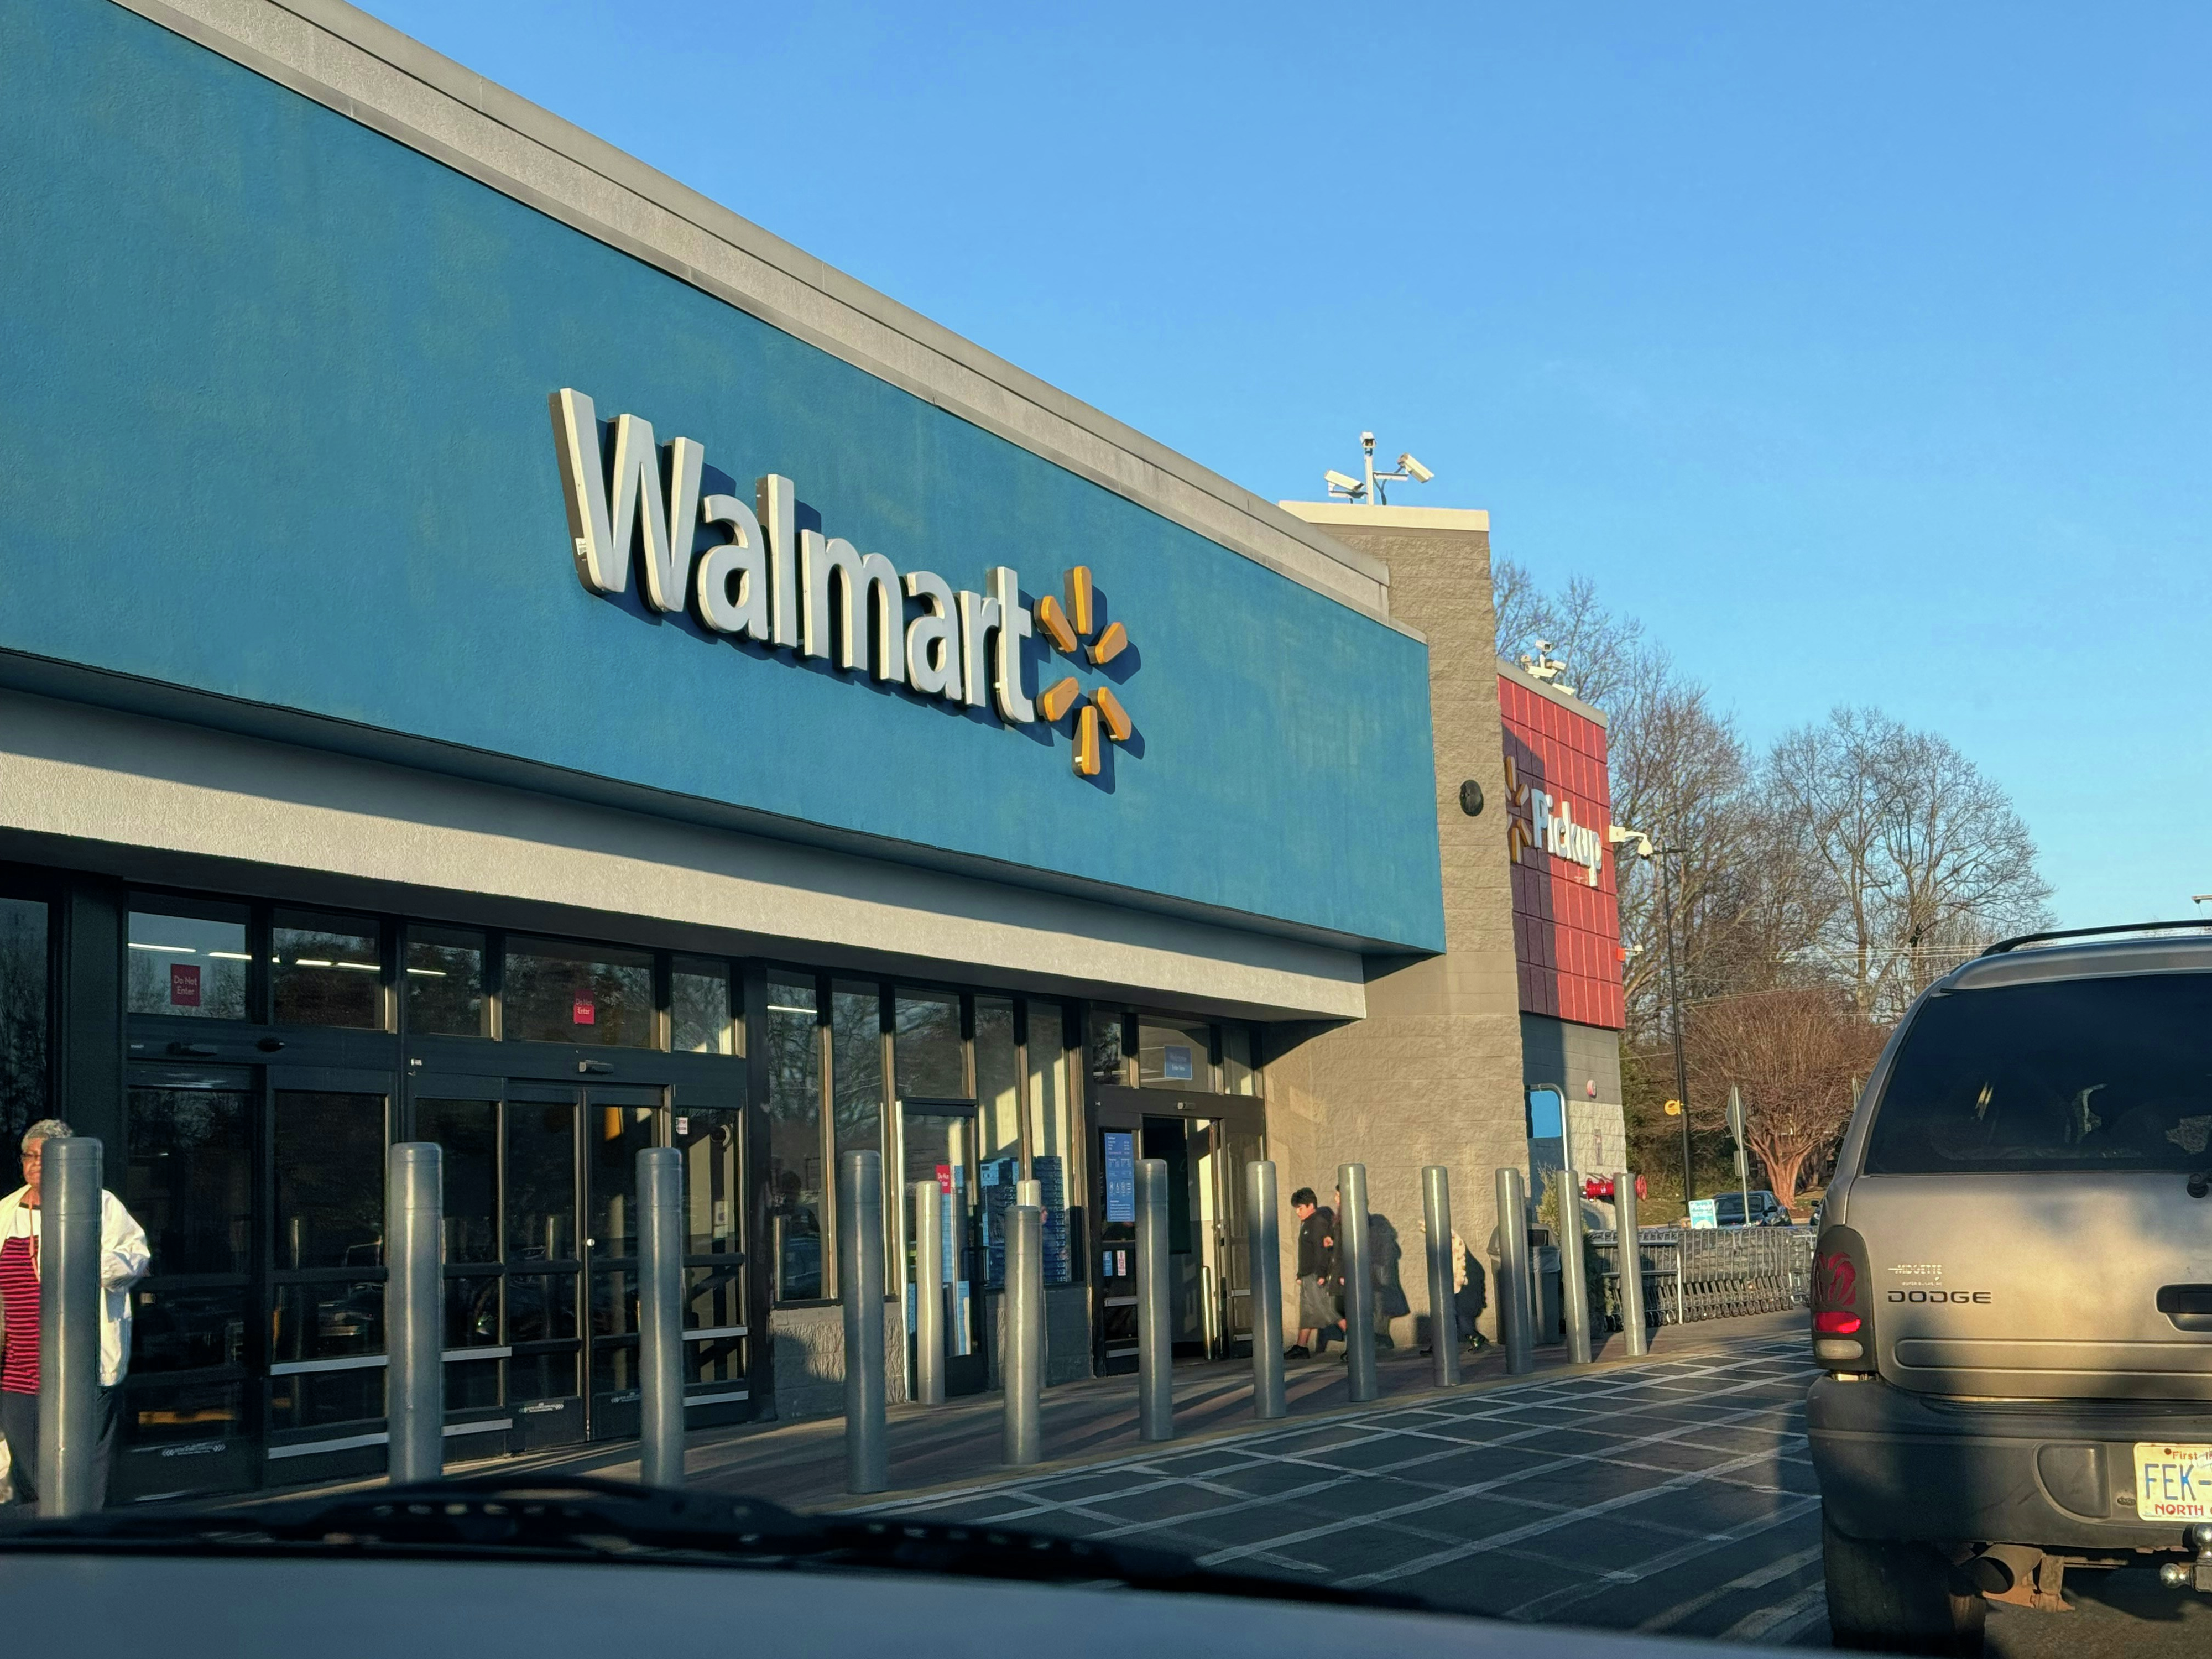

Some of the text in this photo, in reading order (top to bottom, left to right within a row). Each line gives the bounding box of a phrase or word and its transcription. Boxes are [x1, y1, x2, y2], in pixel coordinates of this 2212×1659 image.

[550, 388, 1034, 723] Walmart
[1531, 788, 1603, 887] Pickup
[174, 975, 197, 986] Do Not
[177, 985, 195, 995] Enter
[577, 1006, 590, 1015] Enter
[1887, 1290, 1992, 1304] DODGE
[2172, 1450, 2198, 1460] First
[2154, 1504, 2204, 1516] NORTH
